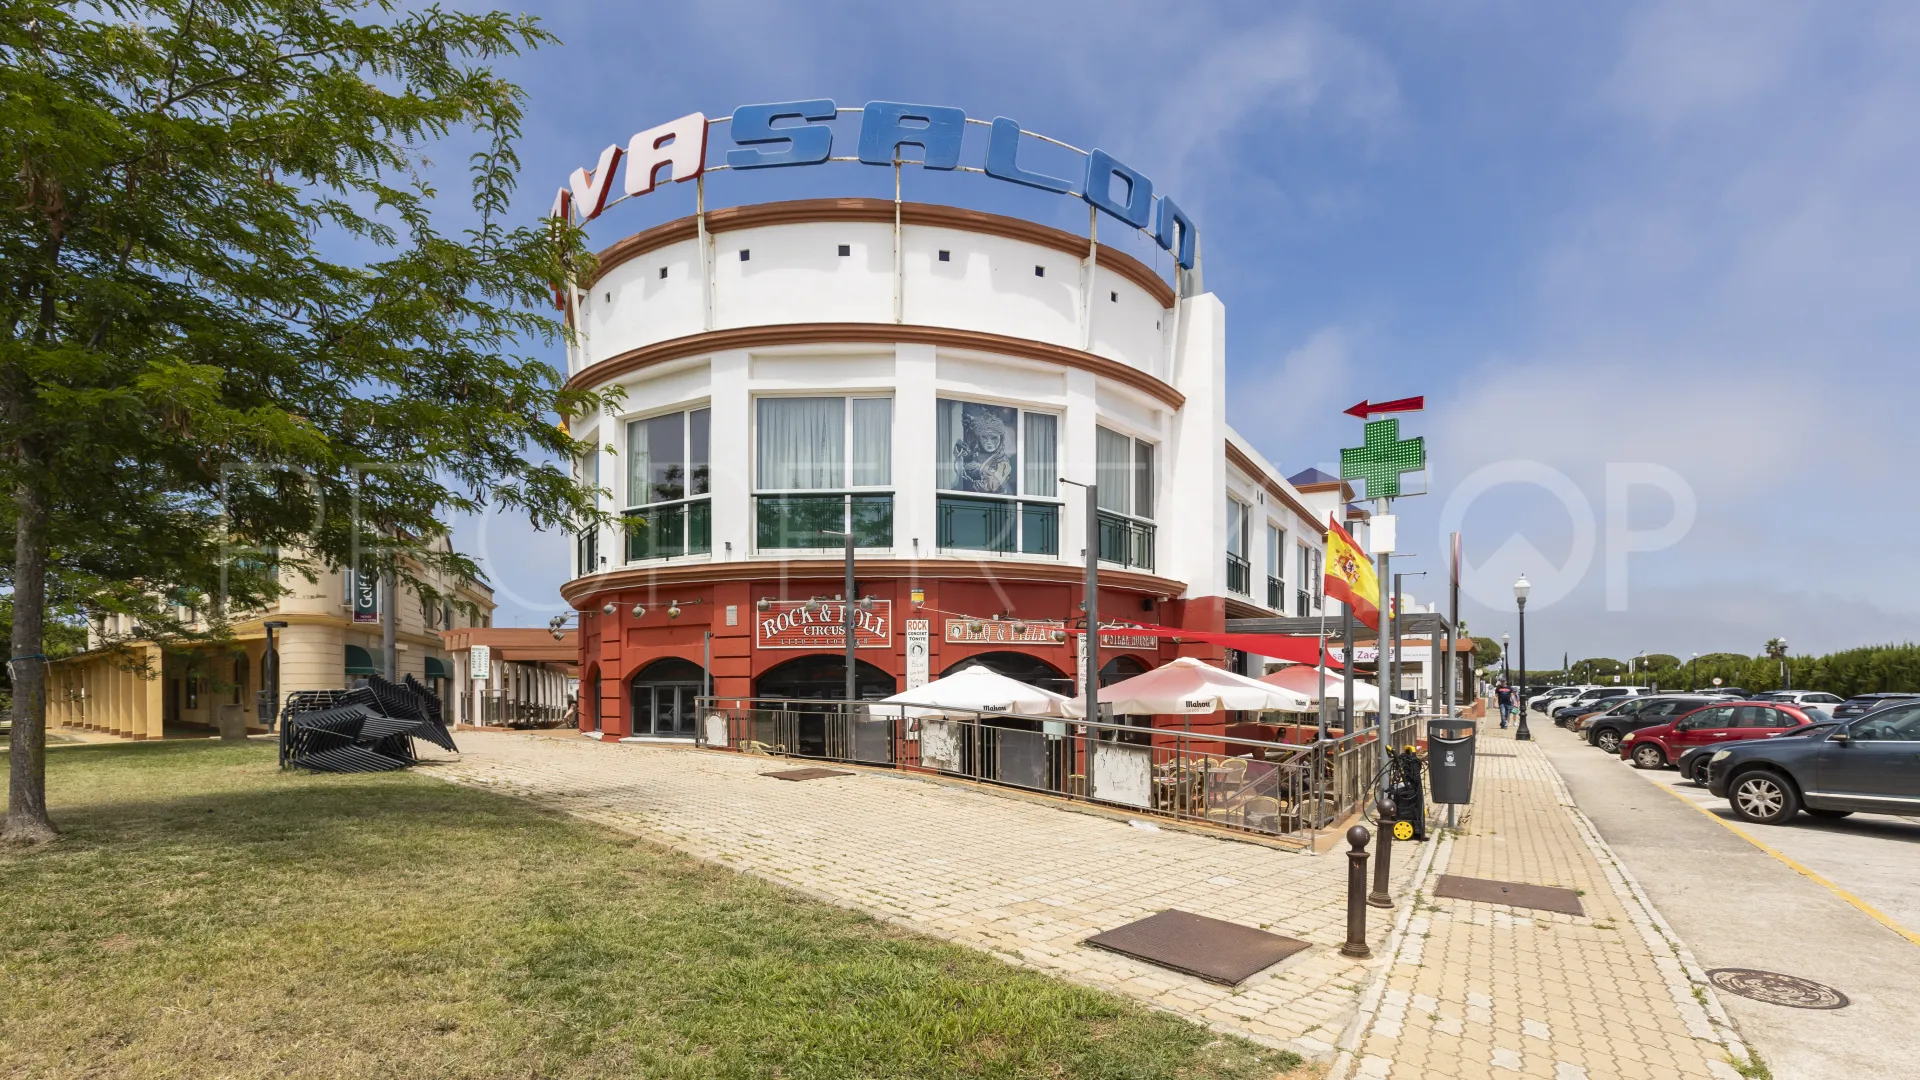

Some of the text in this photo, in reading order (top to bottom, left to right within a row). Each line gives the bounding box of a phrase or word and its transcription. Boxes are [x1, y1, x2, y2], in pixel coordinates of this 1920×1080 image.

[762, 606, 814, 639] ROCK
[820, 604, 831, 622] &
[907, 620, 927, 630] ROCK
[803, 626, 845, 636] CIRCUS
[996, 624, 1005, 640] &
[1185, 700, 1211, 708] Mahou
